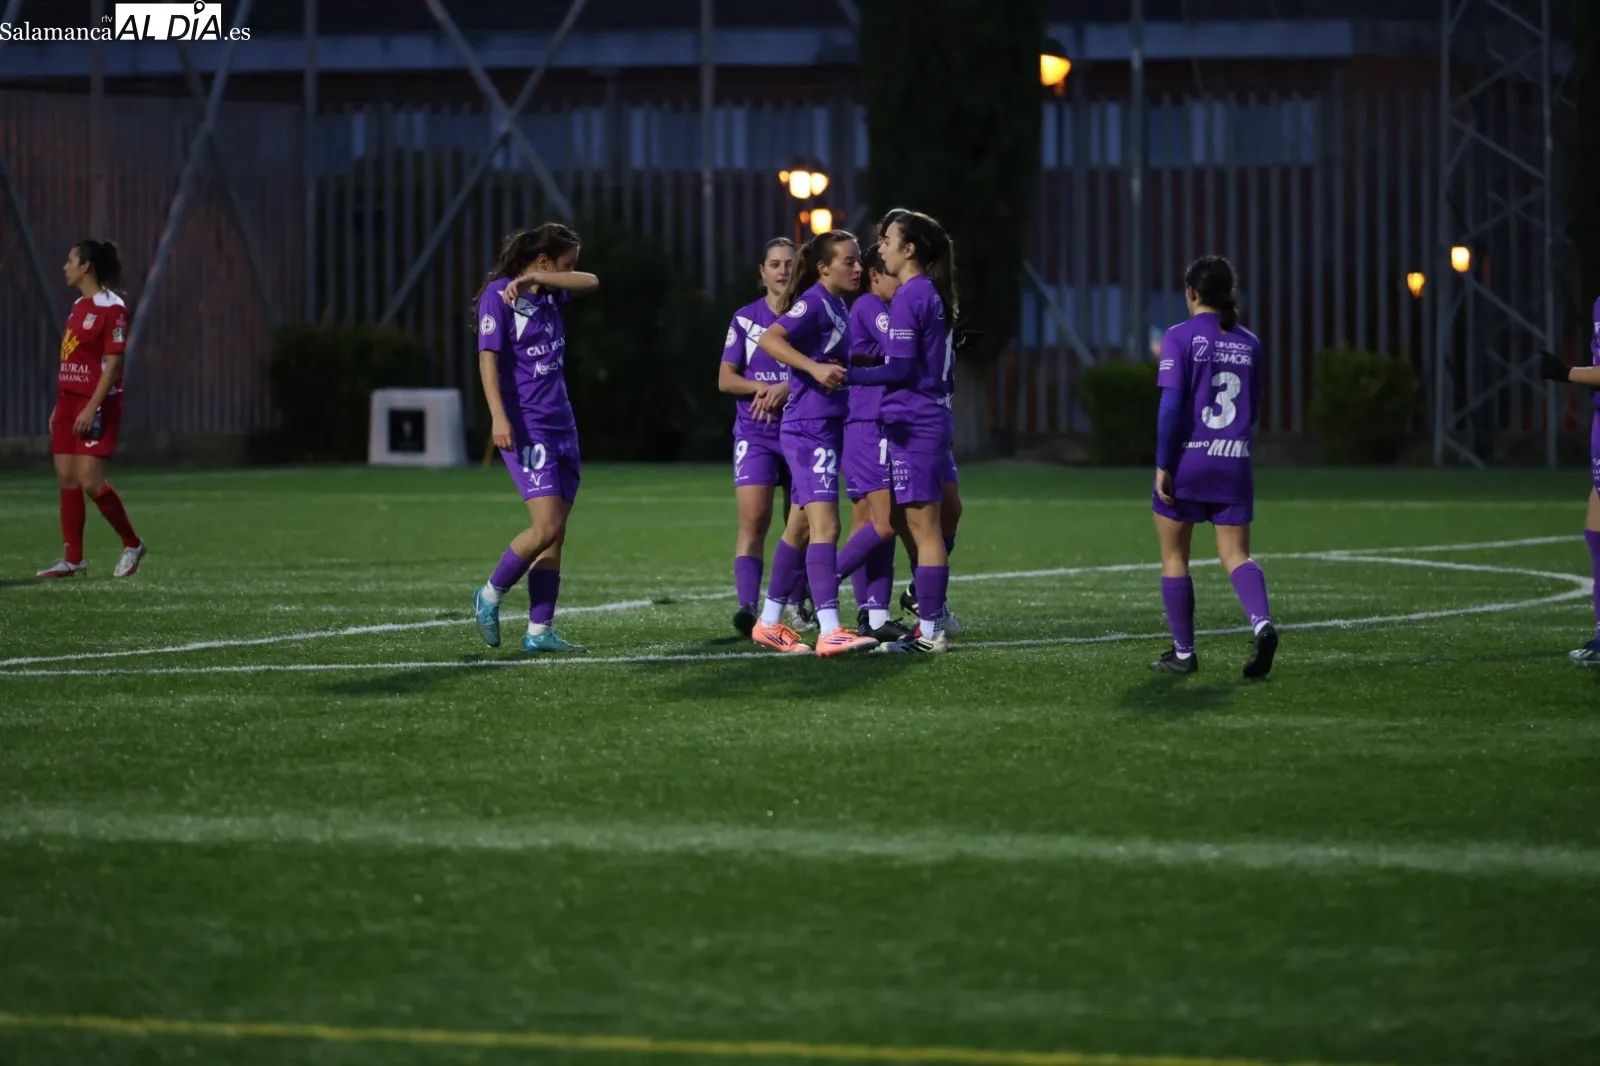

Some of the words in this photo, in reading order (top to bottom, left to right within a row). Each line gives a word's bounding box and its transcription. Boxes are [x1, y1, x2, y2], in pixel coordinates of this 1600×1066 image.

[754, 371, 778, 381] CAJA
[1201, 371, 1242, 430] 3
[521, 443, 546, 473] 10
[735, 440, 749, 464] 9
[812, 447, 838, 475] 22
